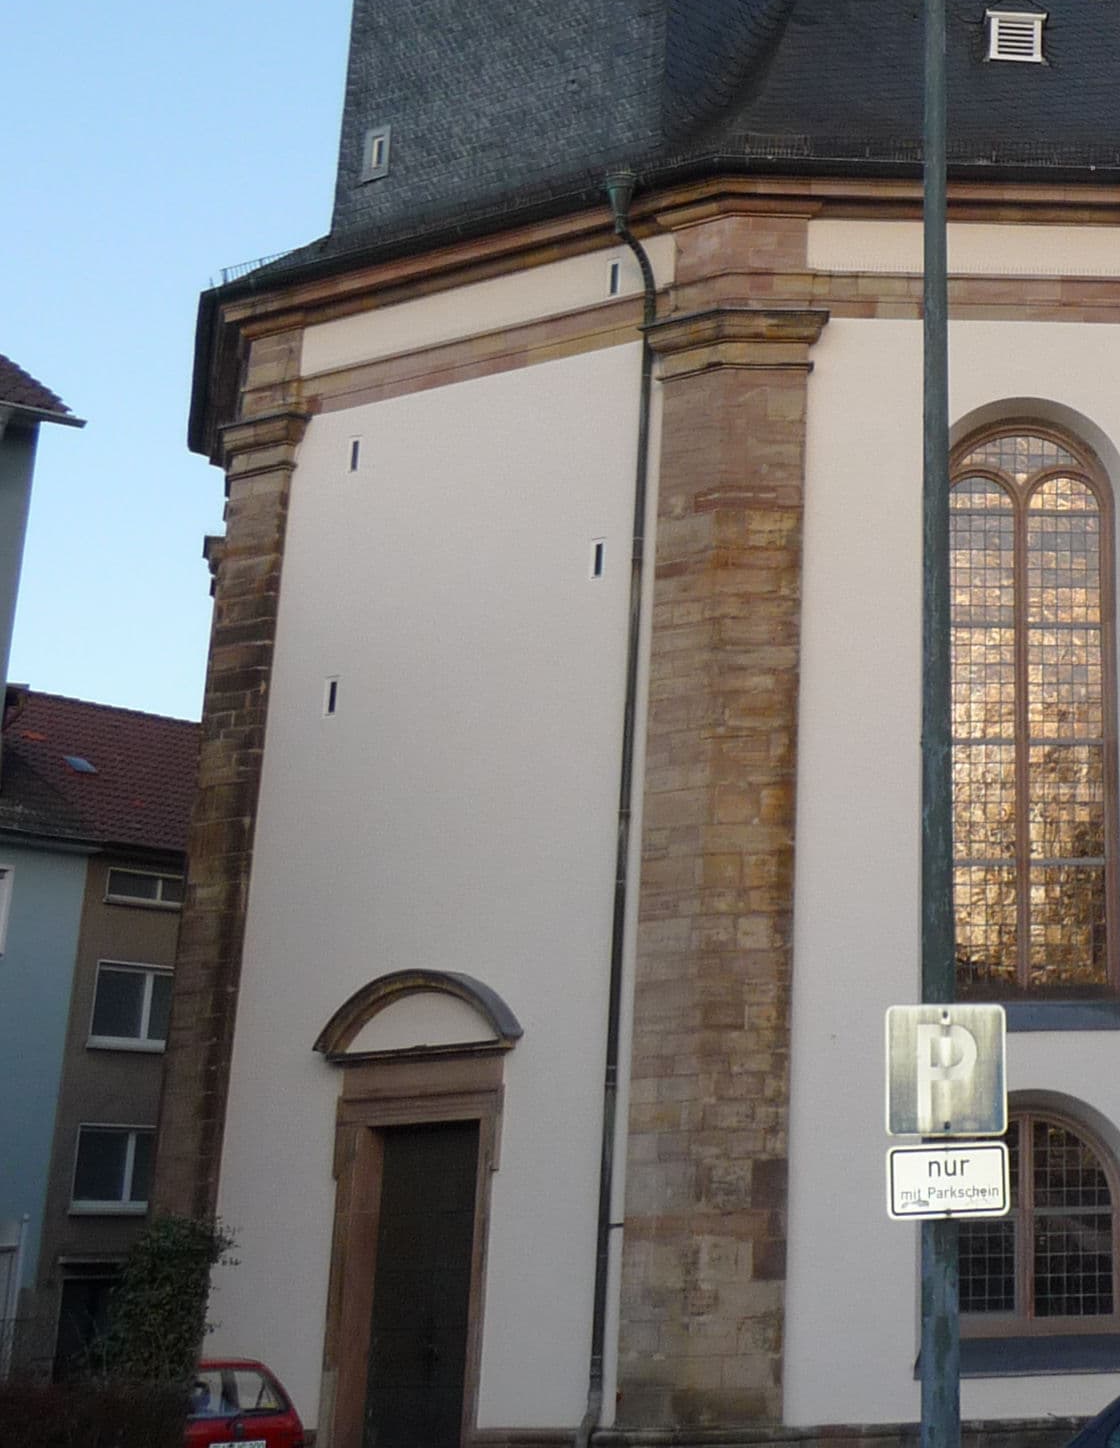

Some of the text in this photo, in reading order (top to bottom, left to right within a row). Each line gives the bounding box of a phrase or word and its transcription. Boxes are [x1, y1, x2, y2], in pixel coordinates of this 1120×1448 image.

[917, 1024, 978, 1133] P
[928, 1158, 971, 1177] nur
[900, 1185, 999, 1202] mit Parkschein
